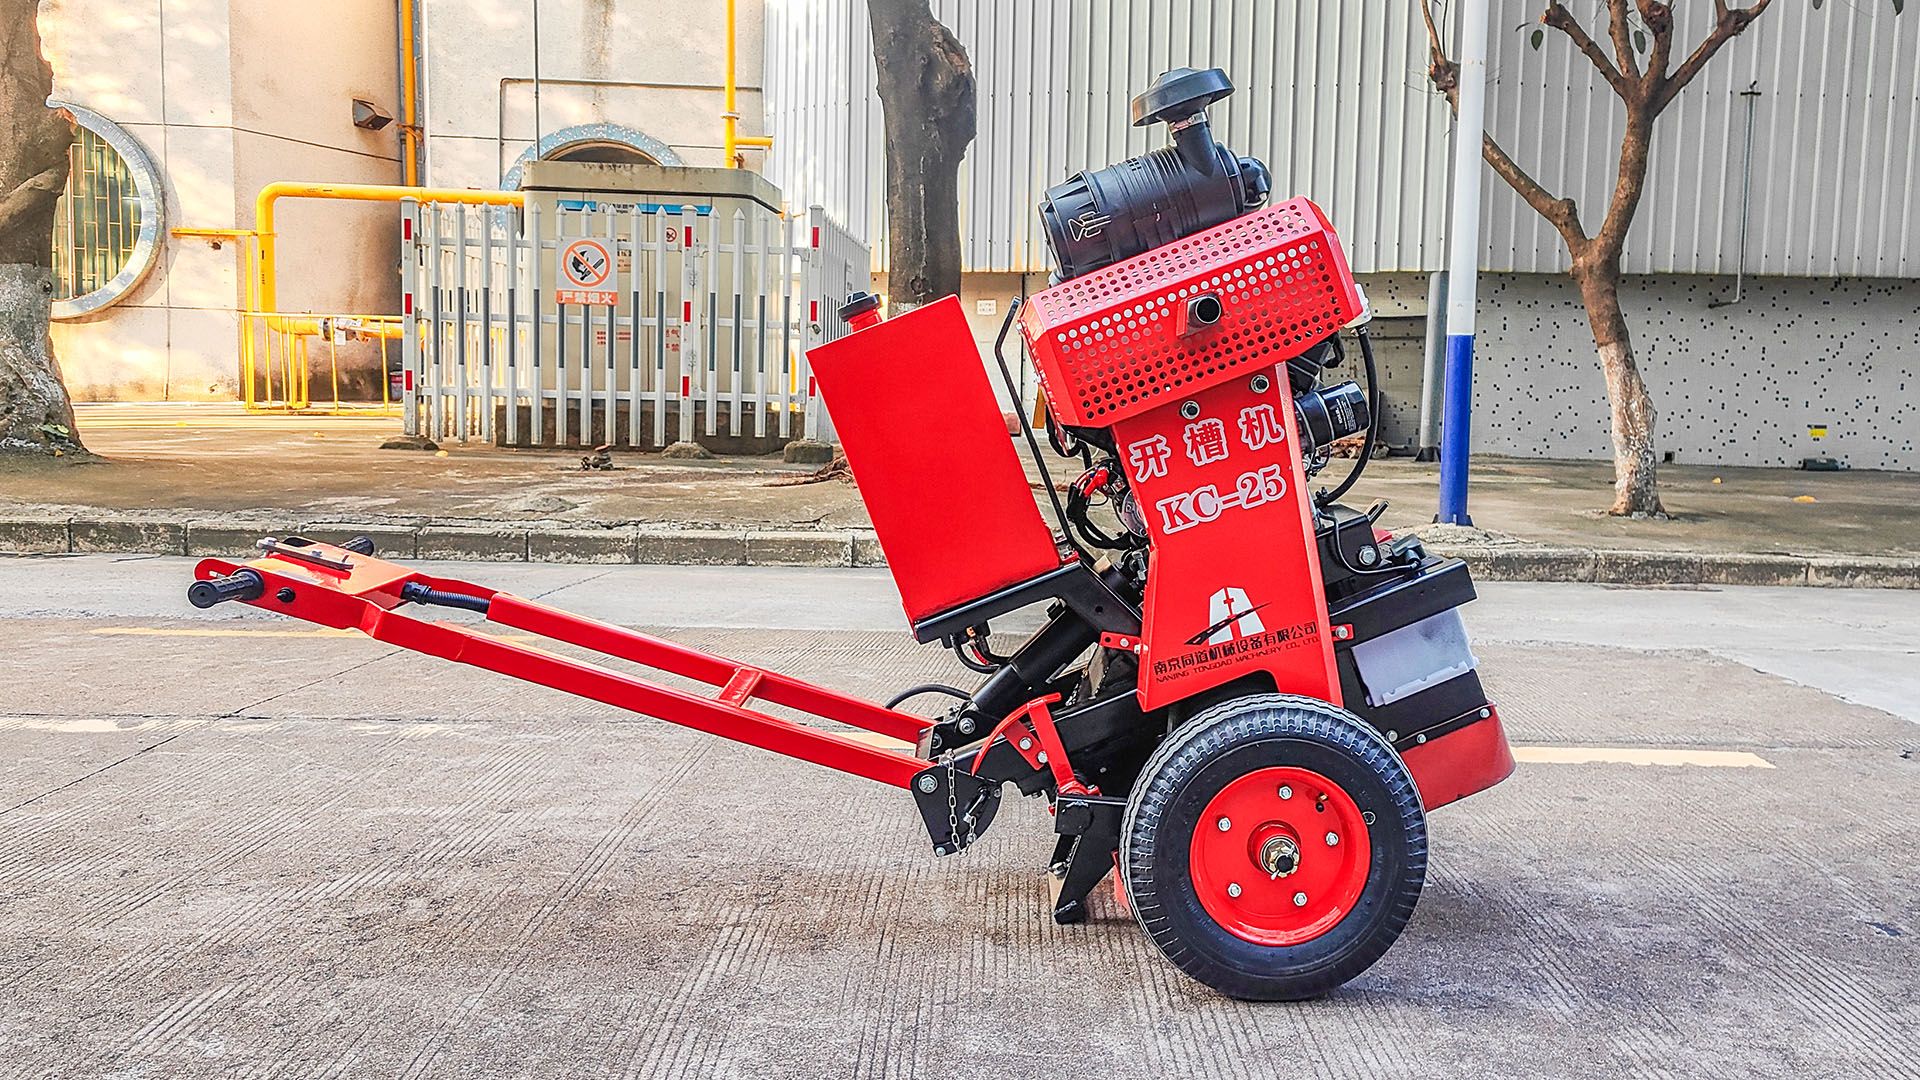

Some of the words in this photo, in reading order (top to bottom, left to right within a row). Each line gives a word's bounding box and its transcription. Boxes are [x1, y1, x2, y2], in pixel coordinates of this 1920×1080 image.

[1129, 405, 1284, 481] 开槽机
[1156, 465, 1287, 533] KC-25
[1154, 622, 1317, 675] 南京同道机械设备有限公司
[1156, 670, 1189, 683] NANJING
[1194, 659, 1232, 673] TONGDAO
